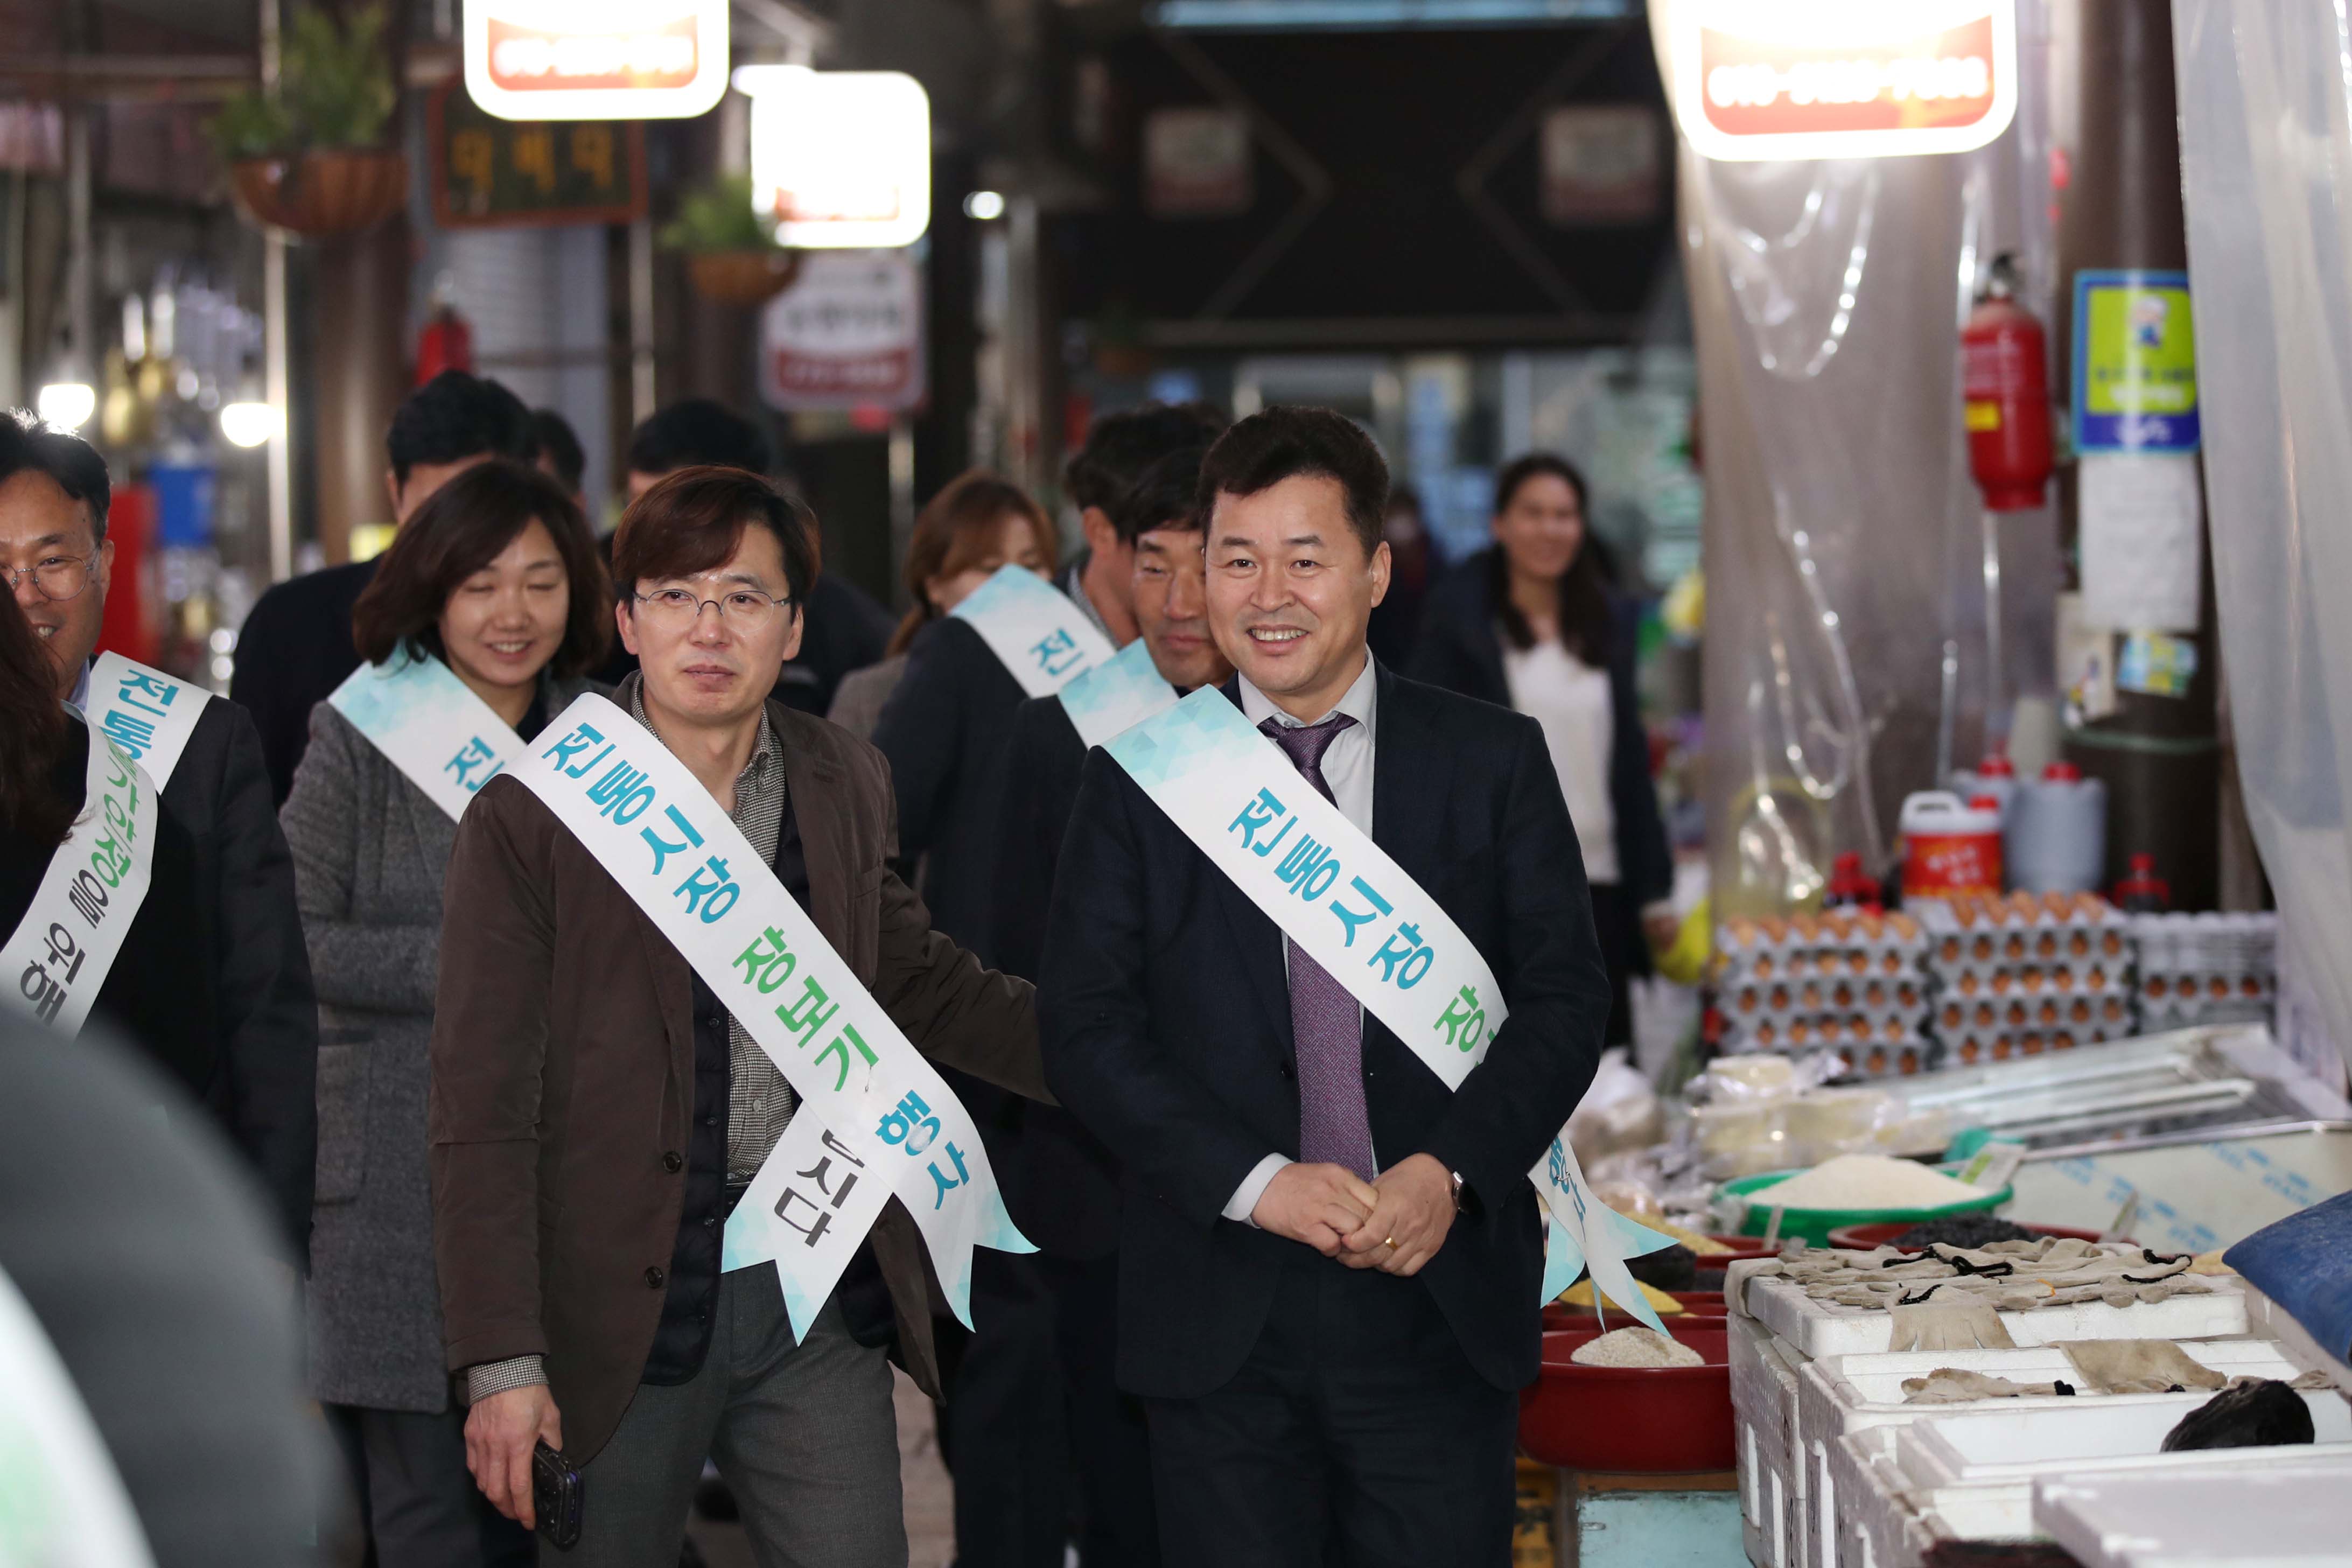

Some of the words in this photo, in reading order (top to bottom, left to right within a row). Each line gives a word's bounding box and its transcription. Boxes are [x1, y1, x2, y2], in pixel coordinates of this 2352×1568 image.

[1028, 628, 1091, 680] 전
[20, 922, 86, 1027] 위해
[541, 722, 740, 924] 전통시장
[732, 925, 879, 1092] 장보기
[875, 1089, 969, 1210] 행사
[1227, 787, 1434, 990] 전통시장
[1433, 984, 1495, 1068] 장
